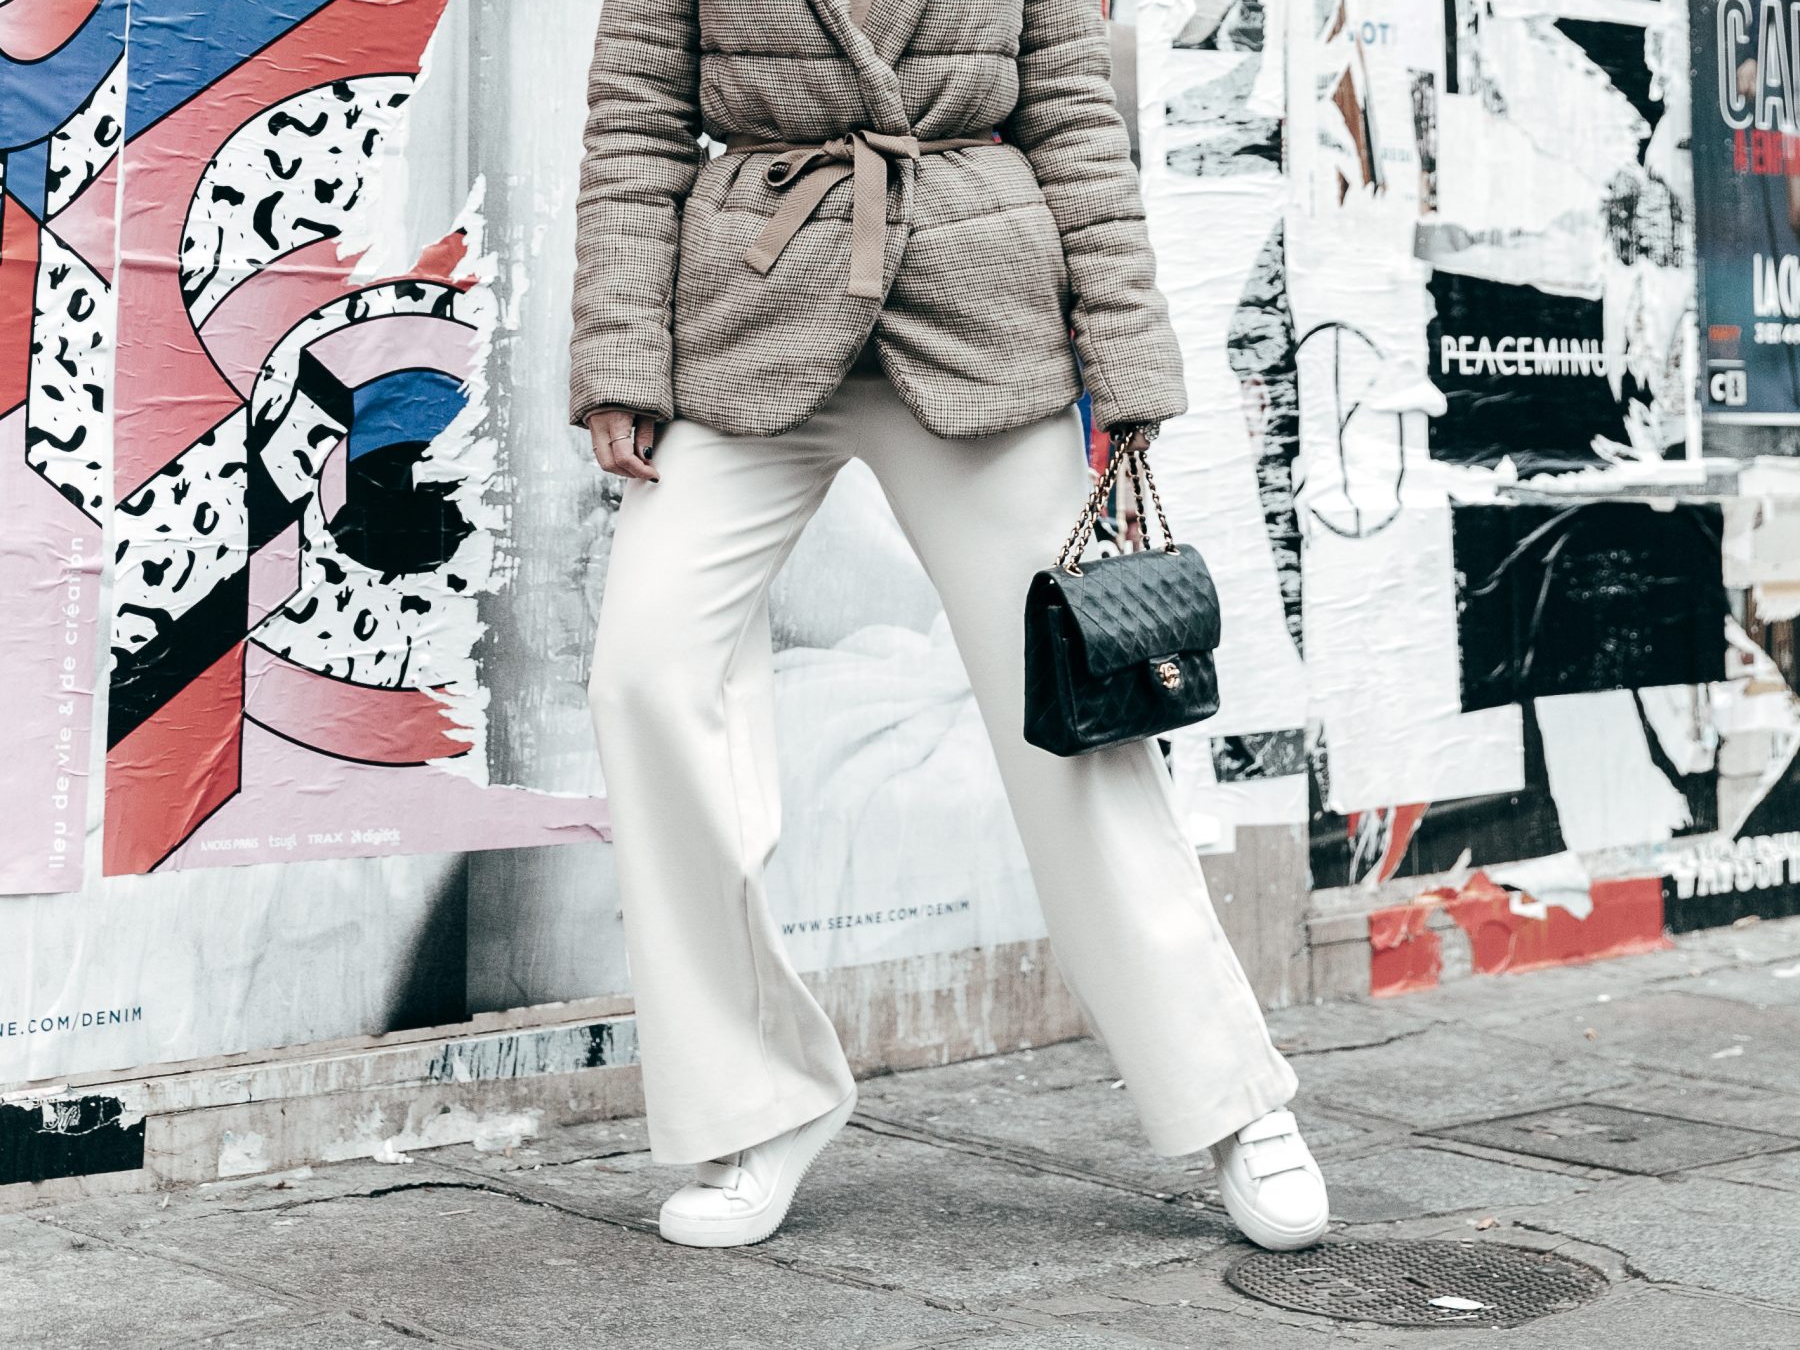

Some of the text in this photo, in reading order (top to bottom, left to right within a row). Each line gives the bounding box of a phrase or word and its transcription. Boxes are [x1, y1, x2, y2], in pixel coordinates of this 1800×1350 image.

[48, 536, 84, 869] lieu de vie & de création
[308, 831, 343, 845] TRAX
